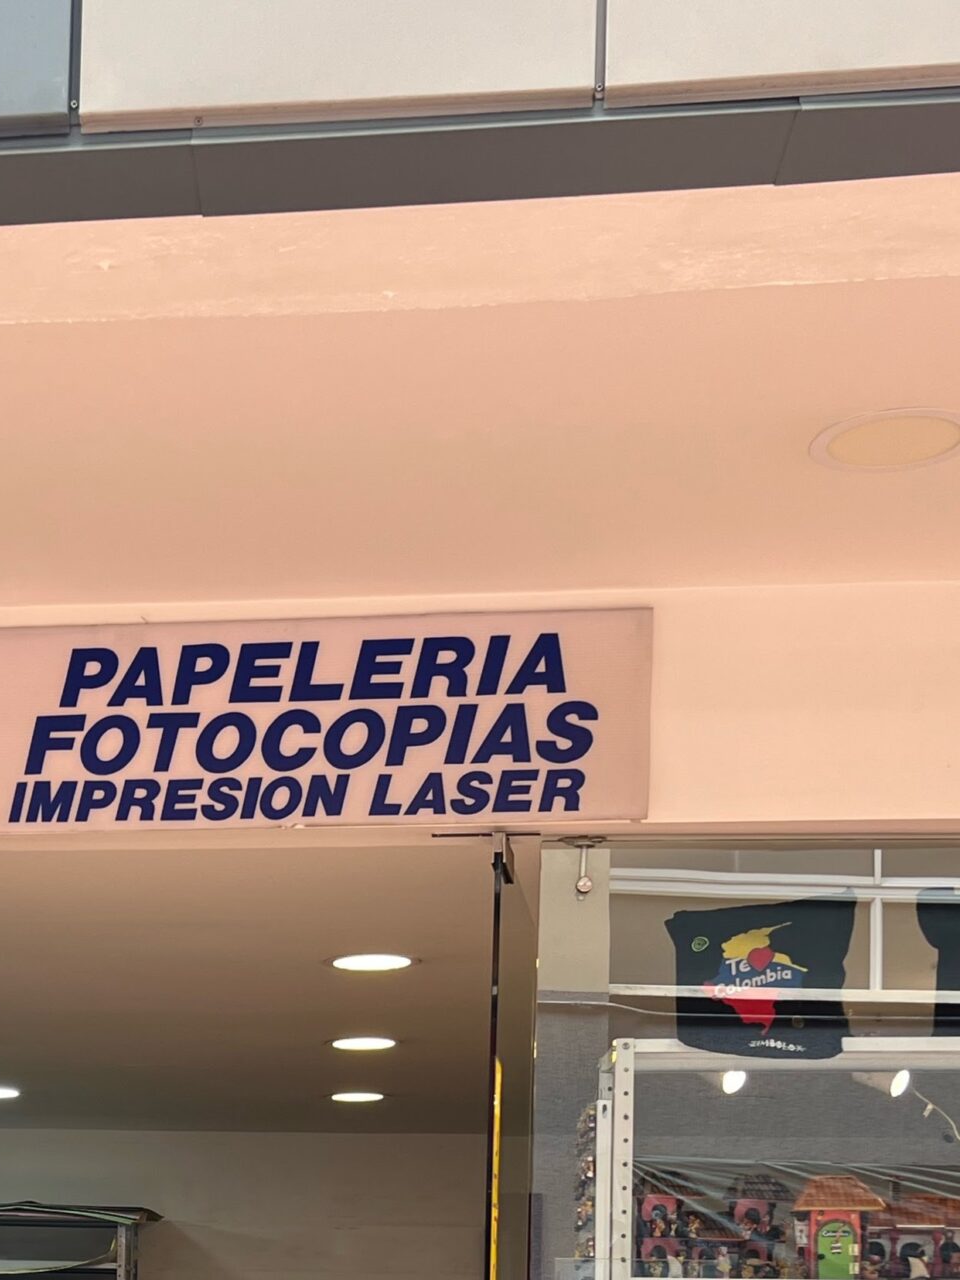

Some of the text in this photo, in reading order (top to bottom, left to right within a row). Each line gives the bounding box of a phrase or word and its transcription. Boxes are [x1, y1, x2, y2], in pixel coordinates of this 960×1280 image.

[59, 633, 567, 708] PAPELERIA
[23, 700, 599, 776] FOTOCOPIAS
[8, 769, 586, 823] IMPRESION LASER
[714, 967, 793, 999] Colombia
[725, 958, 751, 977] Te
